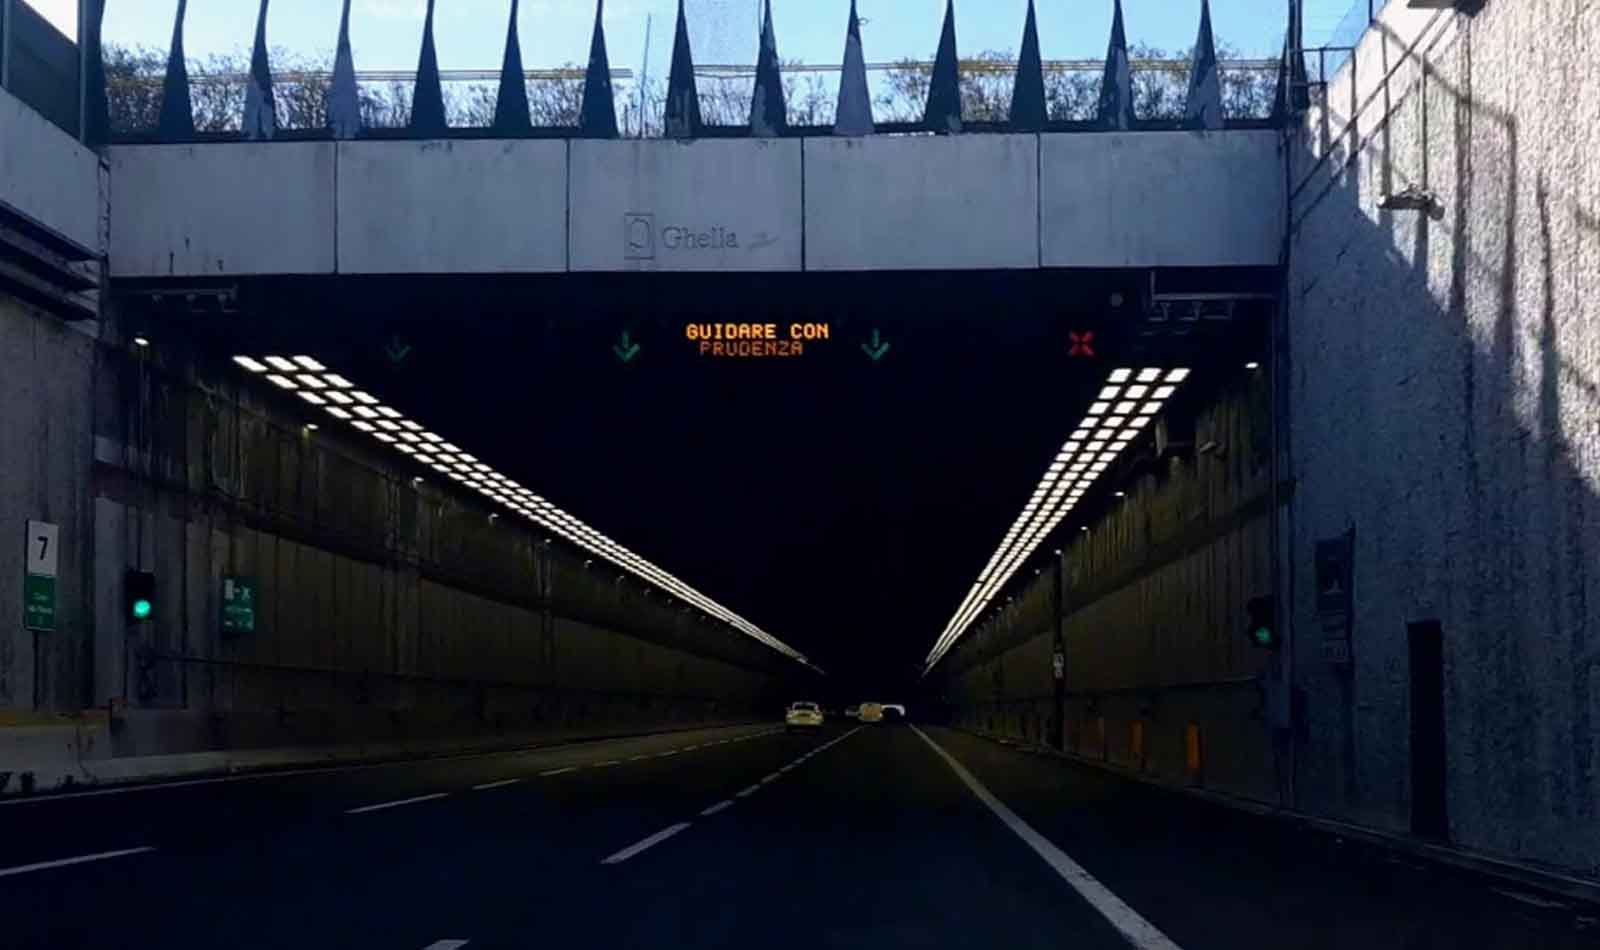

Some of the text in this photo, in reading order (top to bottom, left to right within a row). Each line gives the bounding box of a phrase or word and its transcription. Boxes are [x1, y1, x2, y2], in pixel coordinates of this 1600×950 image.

[662, 226, 739, 249] Ghella
[686, 323, 829, 340] GUIDARE CON
[700, 340, 803, 356] PRUDENZA
[38, 536, 48, 560] 7
